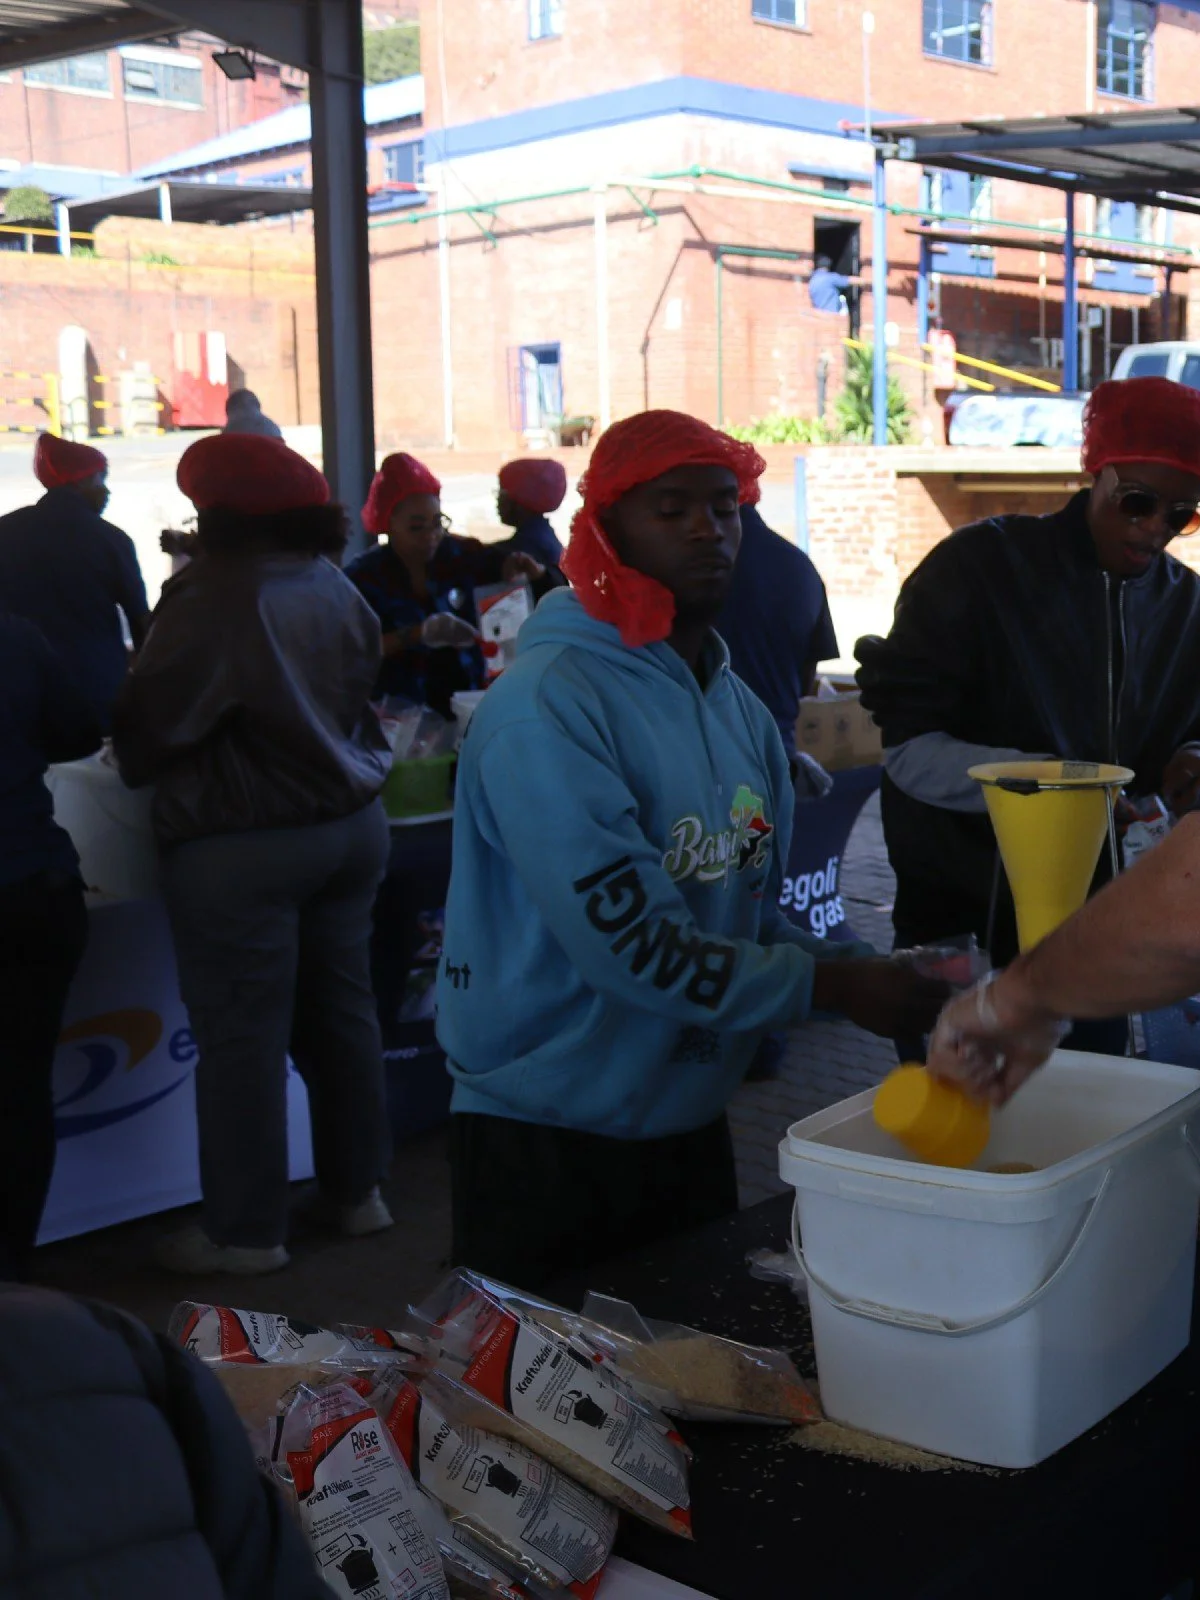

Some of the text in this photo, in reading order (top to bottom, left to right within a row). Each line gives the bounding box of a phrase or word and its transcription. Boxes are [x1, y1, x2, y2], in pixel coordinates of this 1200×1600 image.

[779, 856, 839, 911] egoli
[573, 855, 736, 1010] BANGI
[809, 895, 846, 938] gas
[470, 1326, 510, 1381] NOT FOR RESALE
[351, 1430, 379, 1454] Rise
